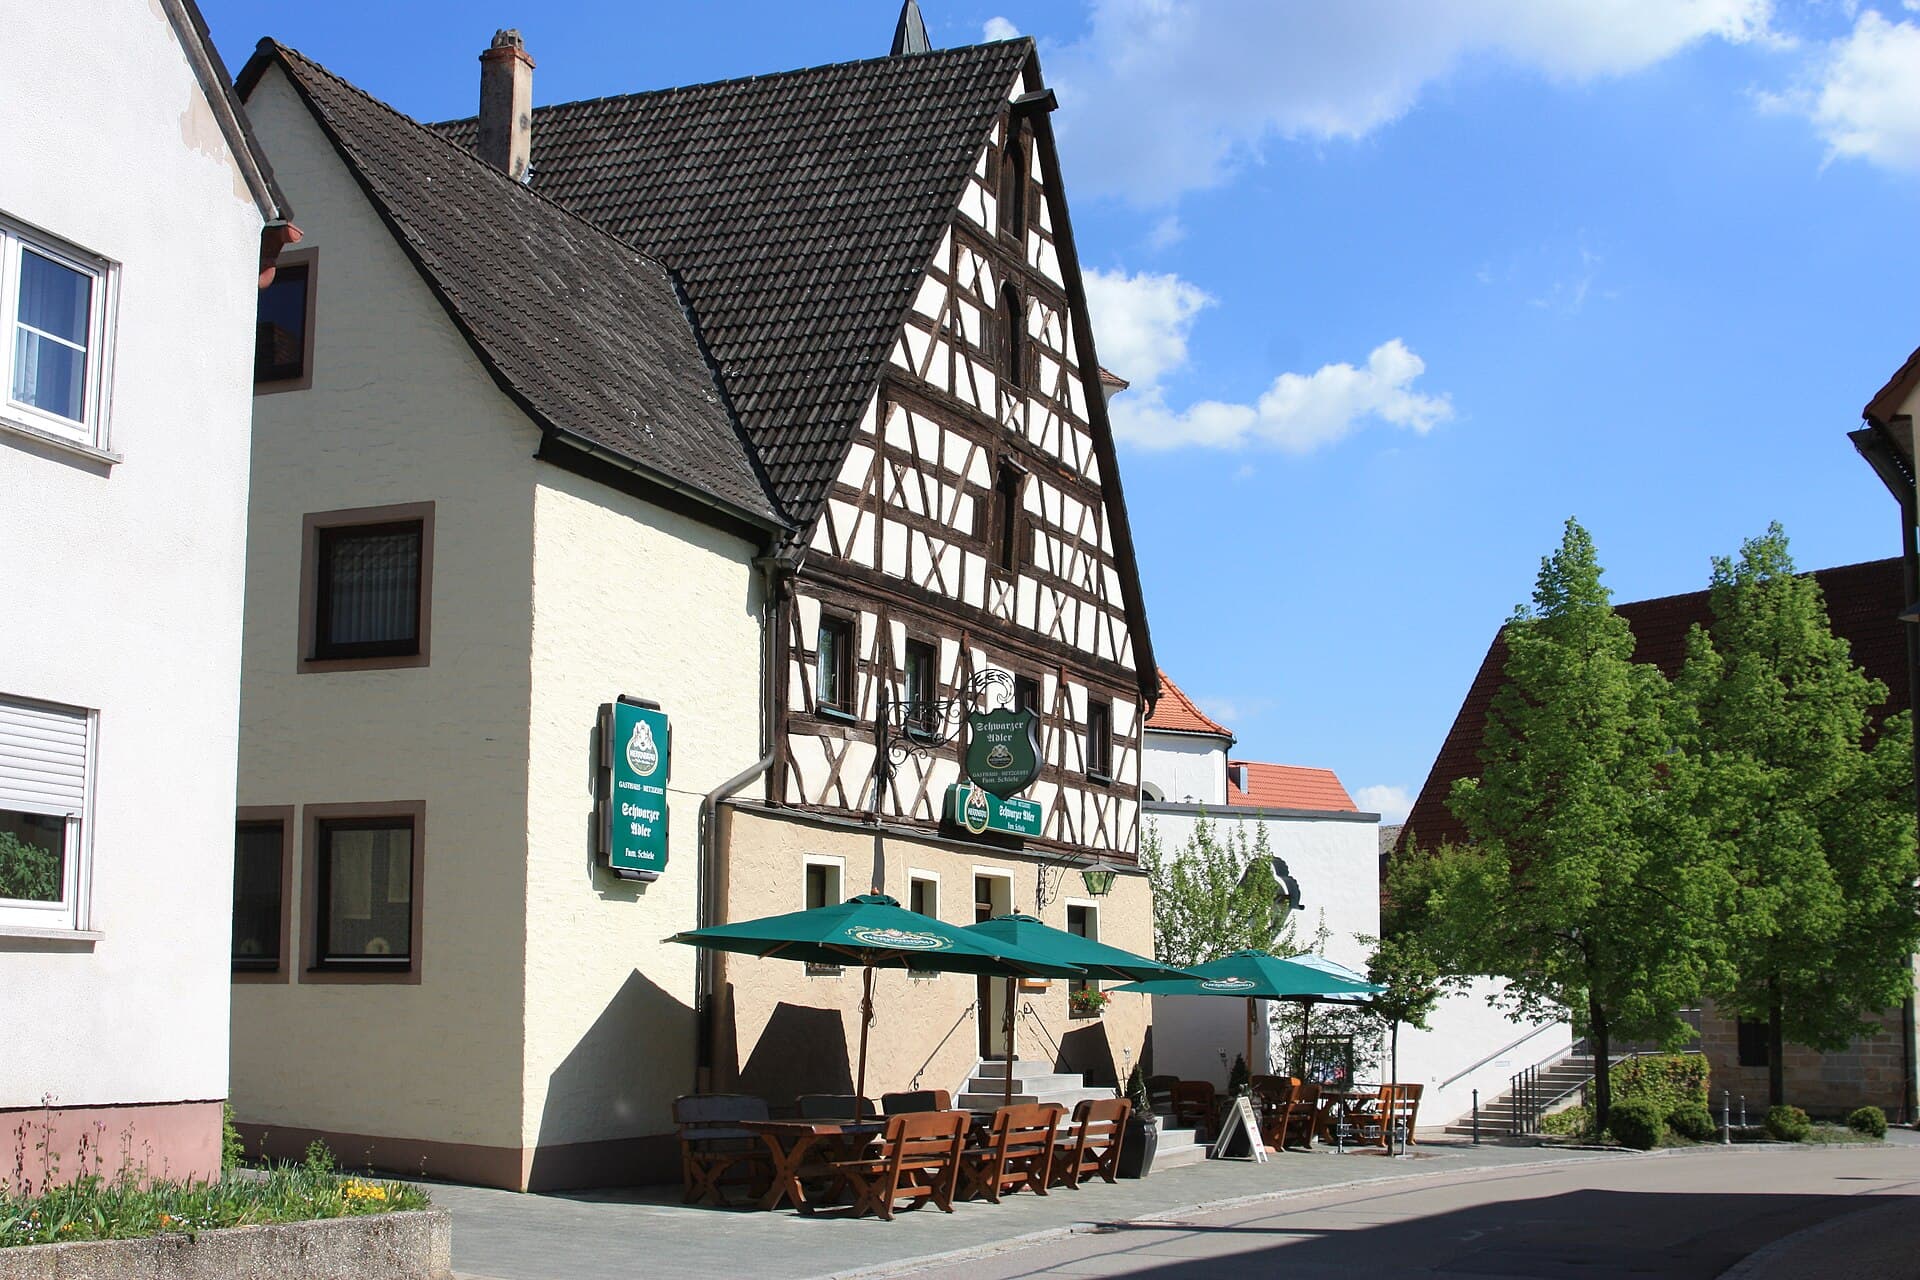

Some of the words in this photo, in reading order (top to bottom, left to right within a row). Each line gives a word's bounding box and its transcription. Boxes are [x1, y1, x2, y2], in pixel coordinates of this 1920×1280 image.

[976, 722, 1023, 732] Schwarzer
[987, 733, 1012, 742] Adler
[622, 802, 660, 823] Schwarzer
[631, 822, 651, 837] Adler
